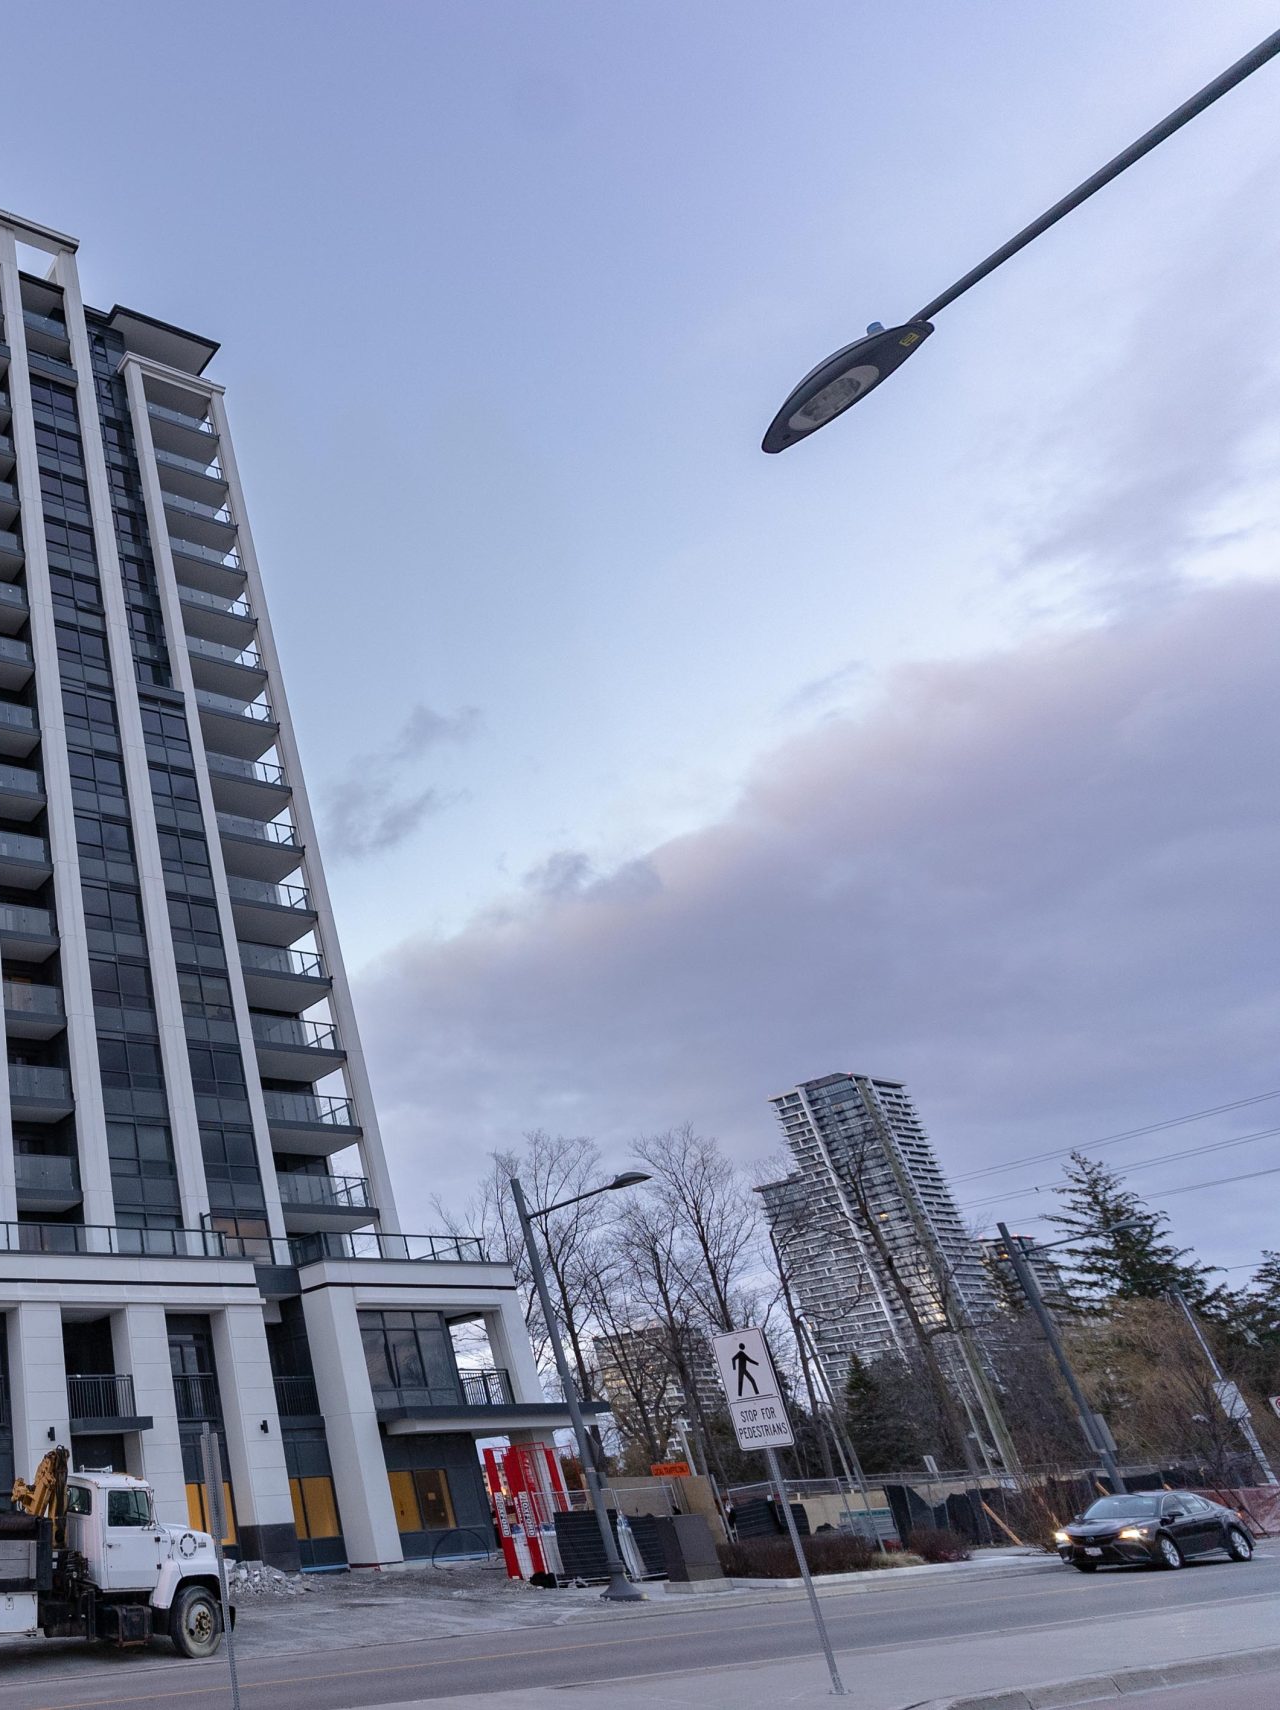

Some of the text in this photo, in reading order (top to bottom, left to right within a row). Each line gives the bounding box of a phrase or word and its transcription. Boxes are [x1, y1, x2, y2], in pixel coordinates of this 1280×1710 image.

[740, 1406, 776, 1423] STOP FOR
[738, 1422, 788, 1439] PEDESTRIANS
